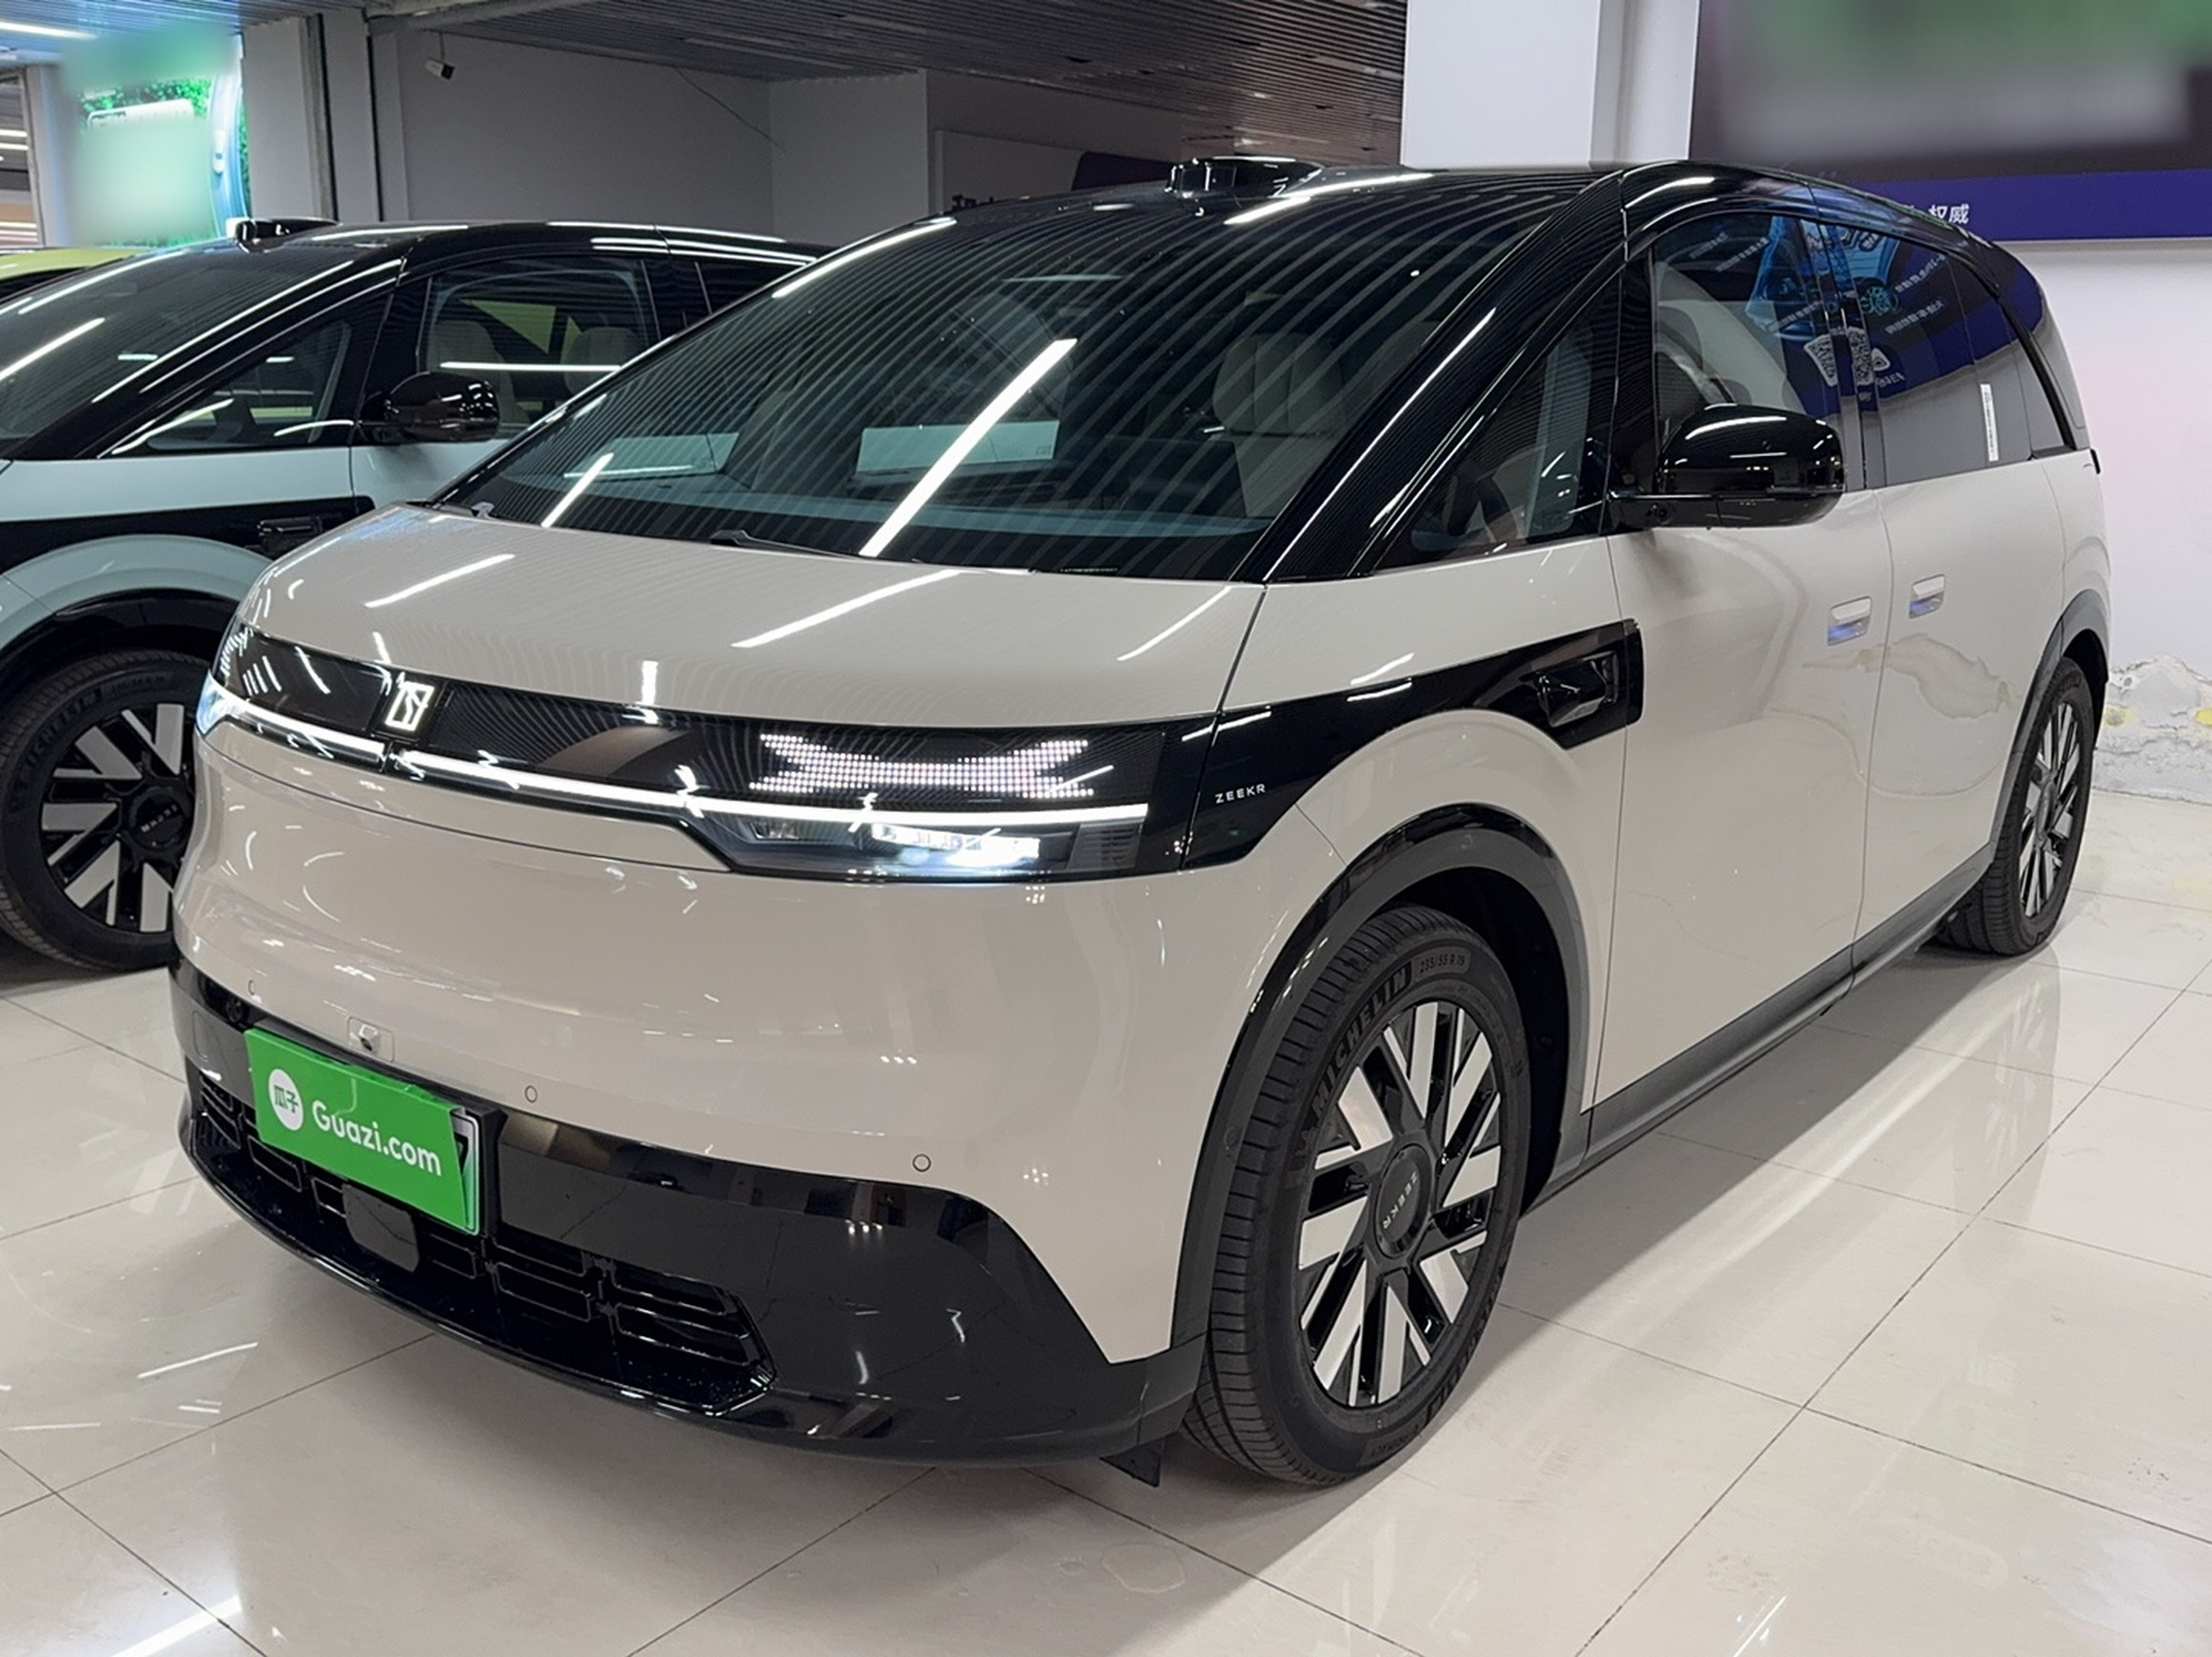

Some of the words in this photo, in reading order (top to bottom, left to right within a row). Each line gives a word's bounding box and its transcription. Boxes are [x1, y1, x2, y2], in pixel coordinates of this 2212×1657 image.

[1215, 784, 1266, 804] ZEEKR
[1311, 967, 1407, 1120] MICHELIN
[274, 1085, 298, 1114] 瓜子
[312, 1100, 442, 1177] Guazi.com
[1383, 1171, 1417, 1228] ZEEKR
